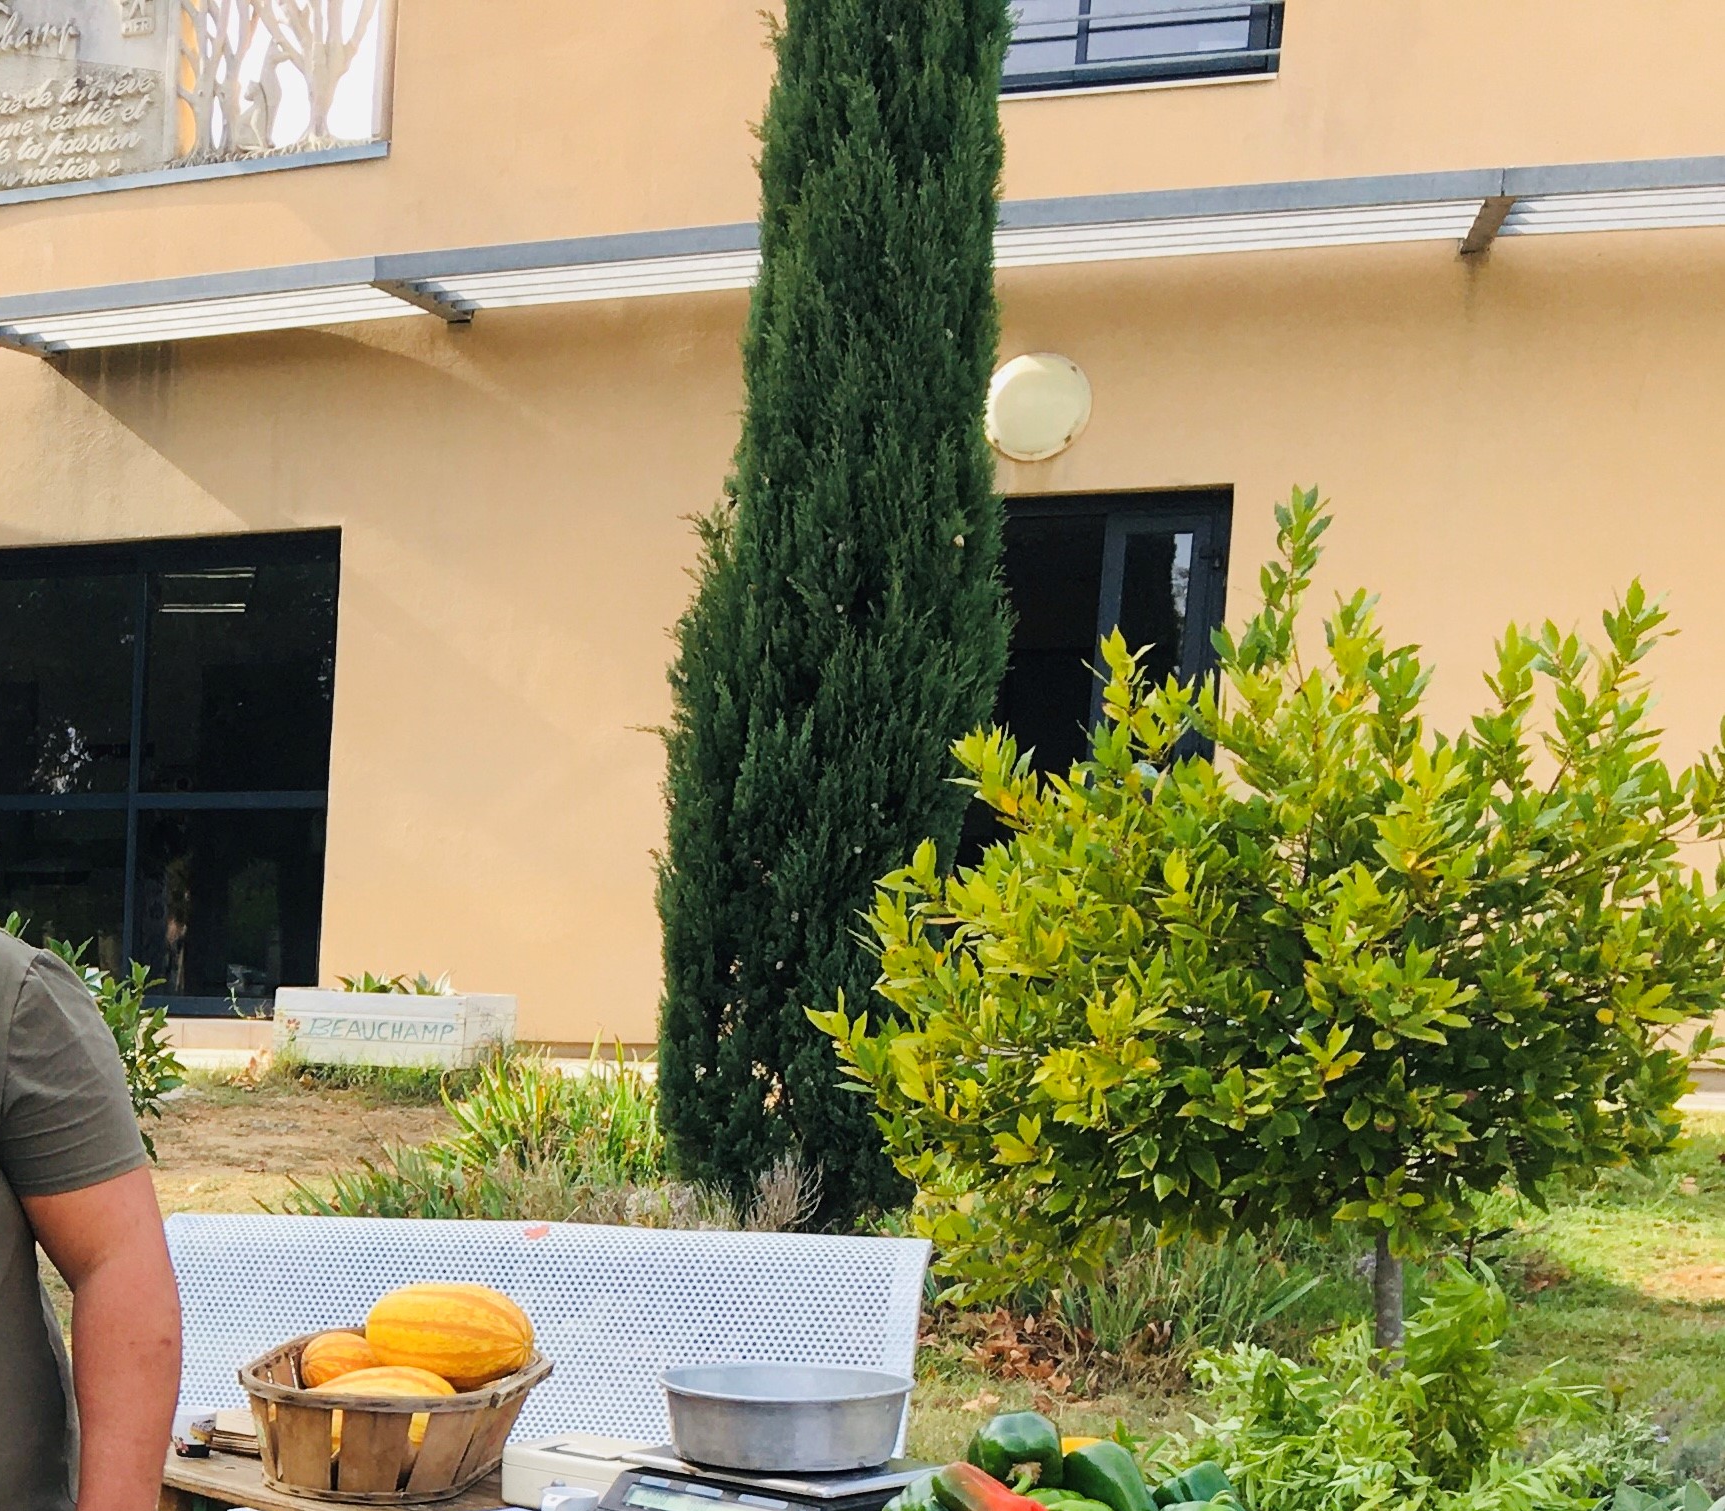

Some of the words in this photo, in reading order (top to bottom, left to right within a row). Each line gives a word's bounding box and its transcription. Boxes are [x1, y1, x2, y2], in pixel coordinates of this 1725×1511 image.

[24, 79, 56, 108] de
[106, 69, 156, 94] rêve
[41, 101, 118, 132] réalité
[121, 94, 151, 122] et
[16, 139, 44, 161] ta
[40, 129, 143, 165] passion
[22, 157, 101, 186] métier
[303, 1017, 454, 1042] BEAUCHAMP
